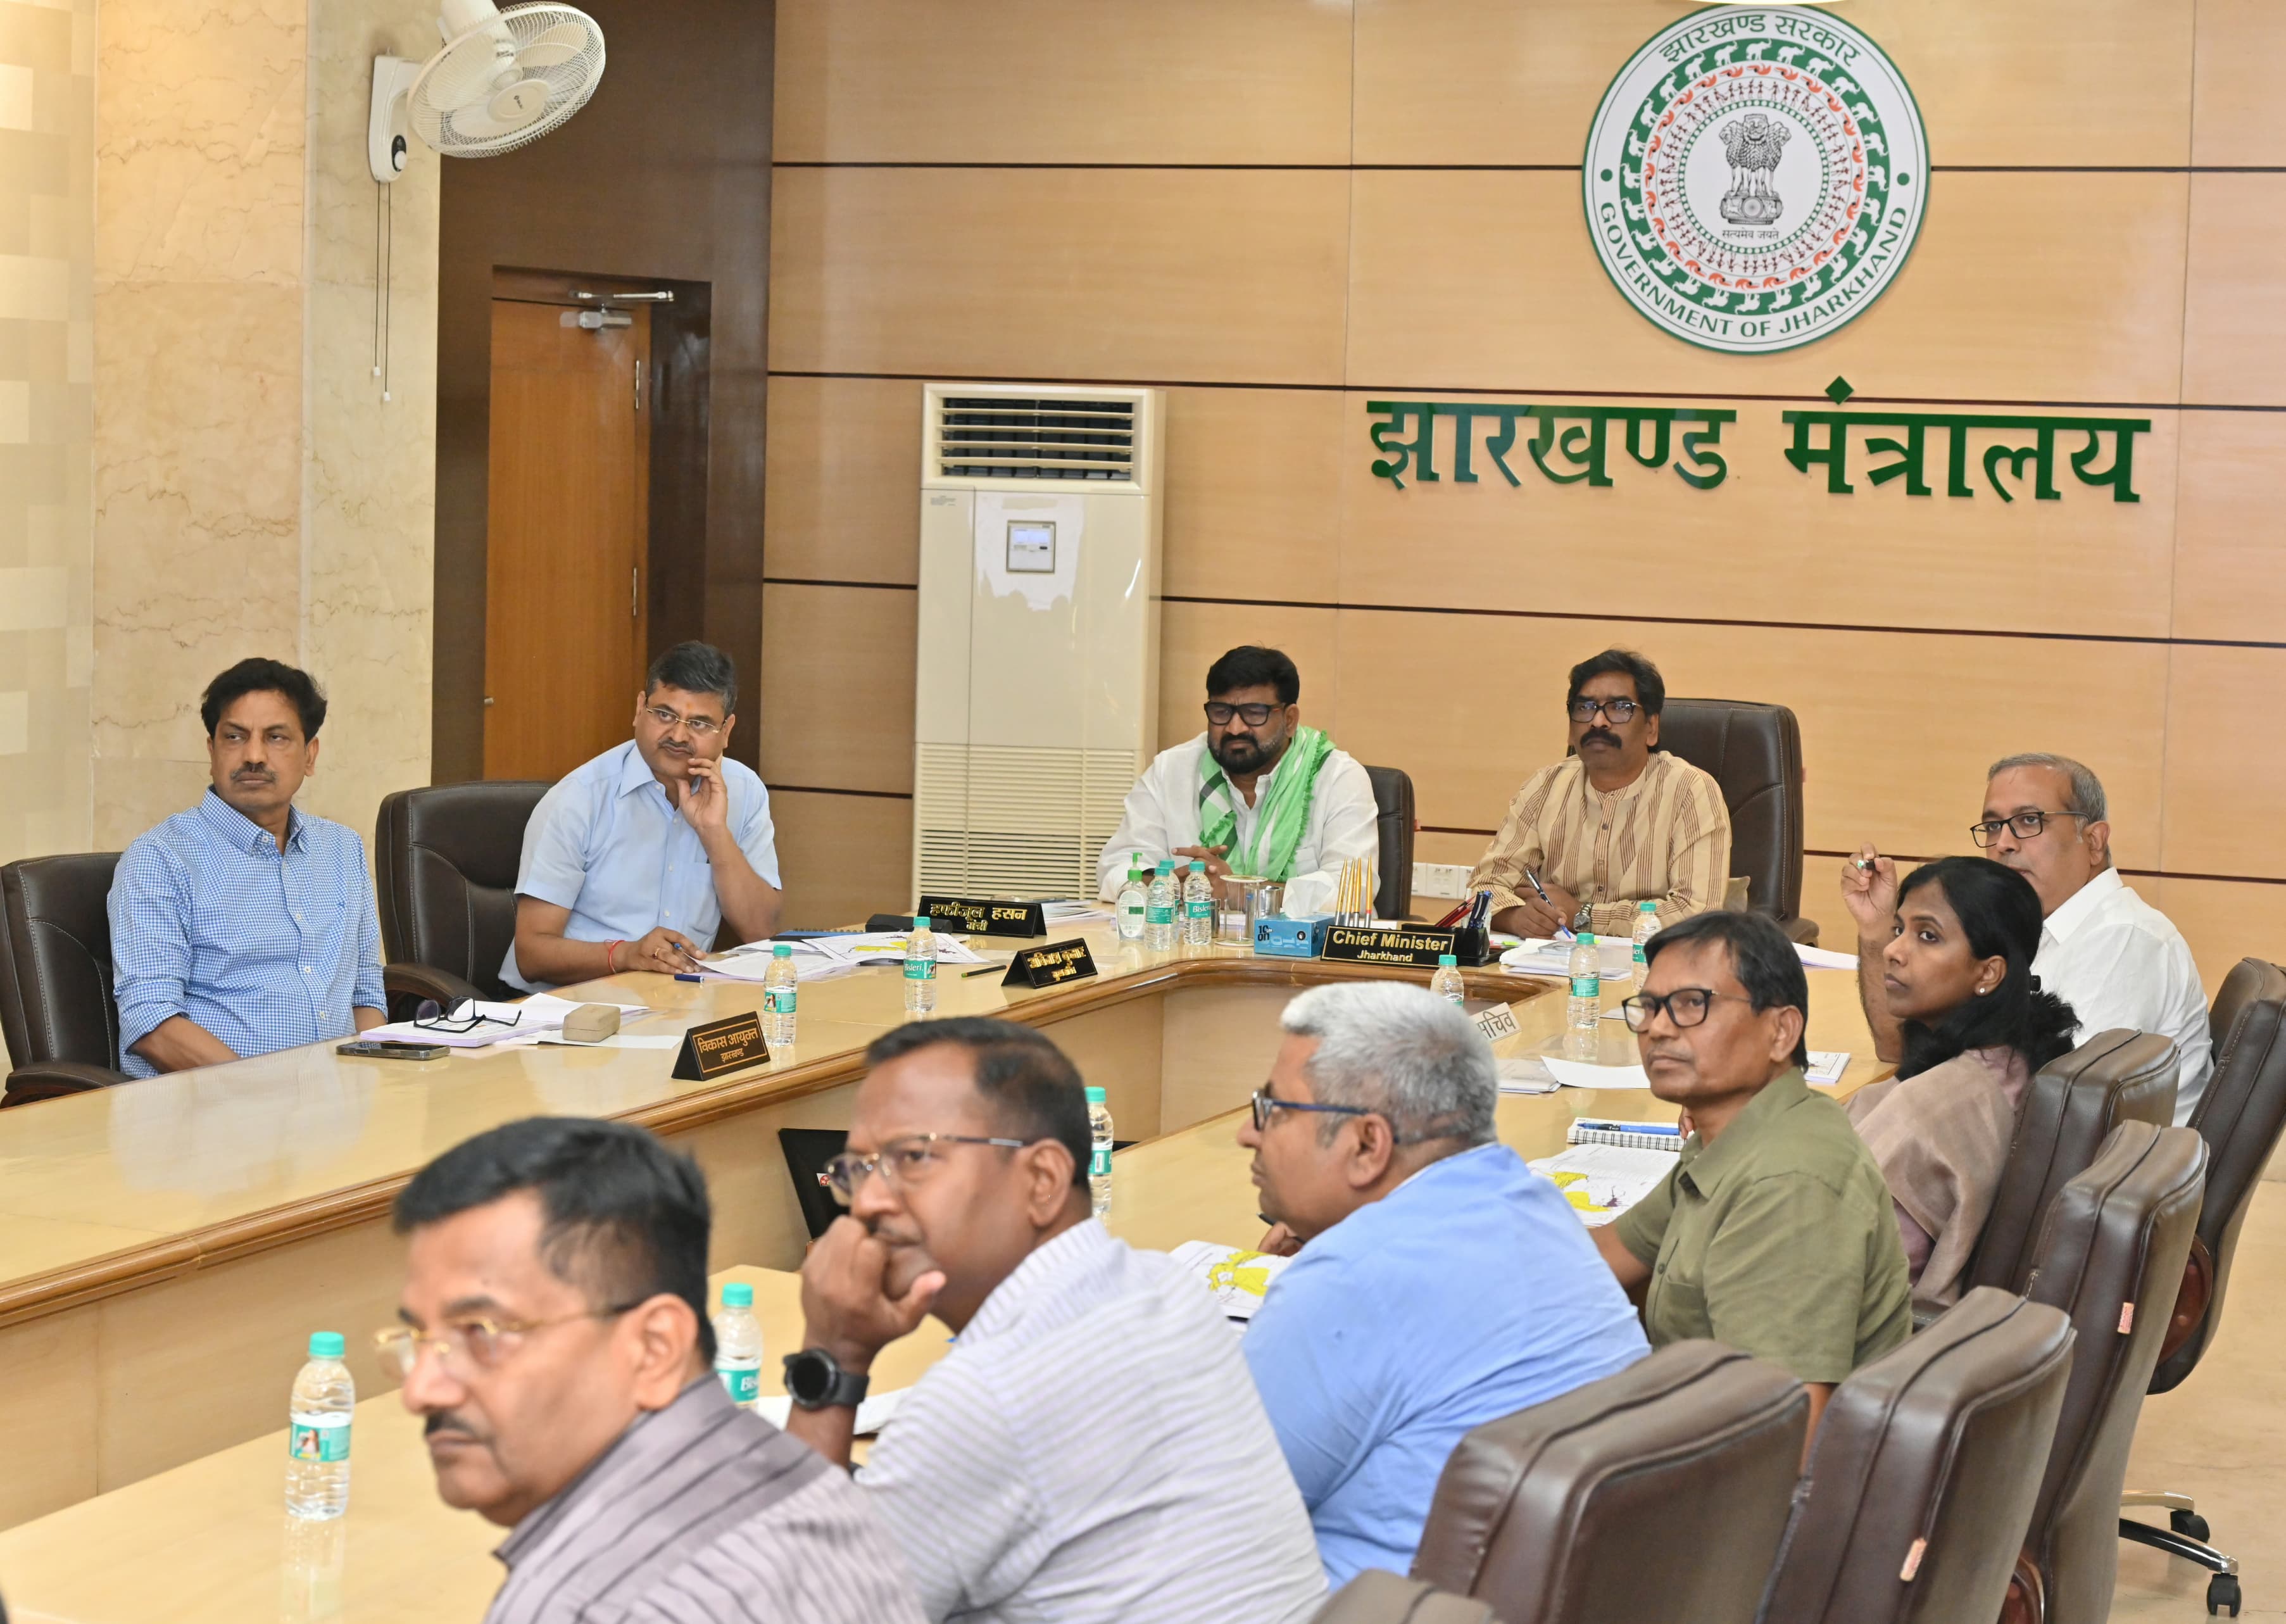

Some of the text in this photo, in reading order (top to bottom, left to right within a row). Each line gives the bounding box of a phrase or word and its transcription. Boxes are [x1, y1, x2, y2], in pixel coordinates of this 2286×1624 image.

[1659, 14, 1861, 65] झारखण्ड सरकार
[1722, 227, 1780, 239] सत्यमेव जयते
[1600, 203, 1906, 337] GOVERNMENT OF JHARKHAND
[1366, 376, 2152, 503] झारखण्ड मंत्रालय
[991, 907, 1027, 920] हसन
[966, 919, 988, 931] मंत्री
[1333, 930, 1448, 951] Chief Minister
[1357, 950, 1413, 962] Jharkhand
[697, 1027, 759, 1054] विकास आयुक्त
[720, 1048, 744, 1064] झारखण्ड
